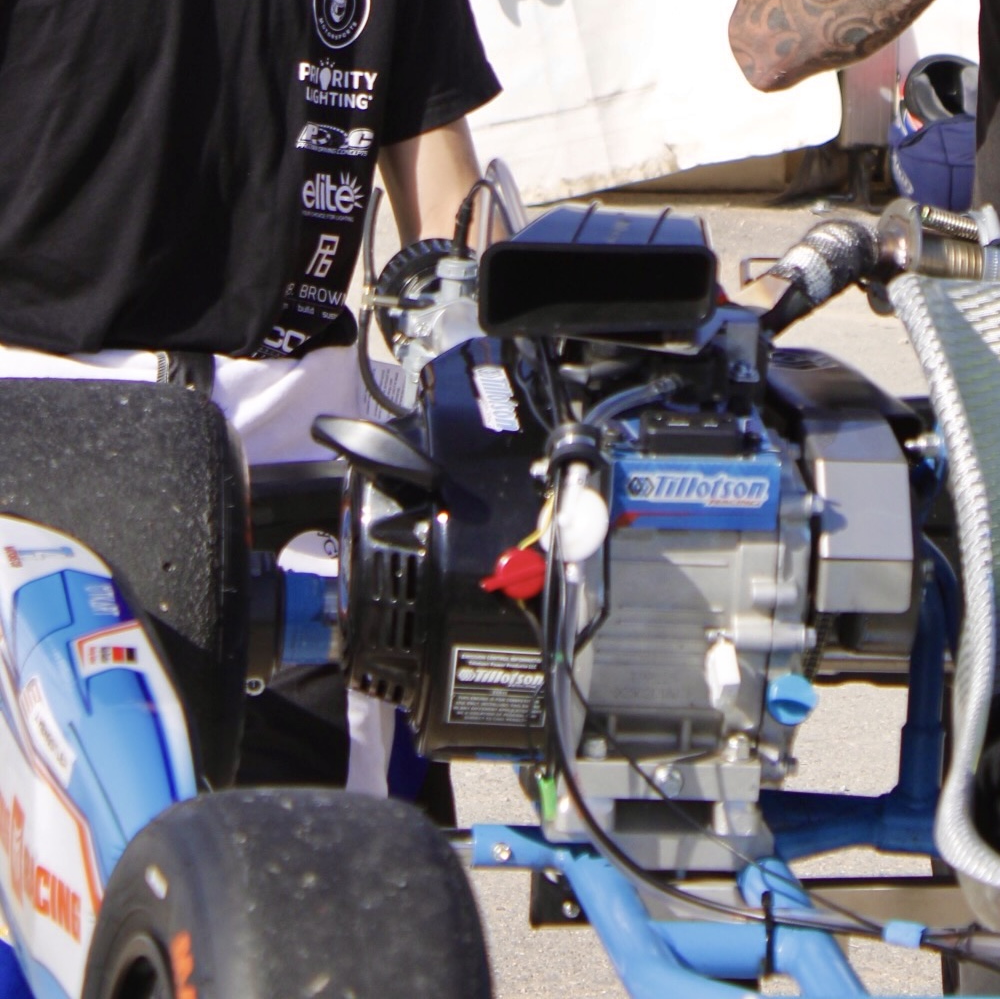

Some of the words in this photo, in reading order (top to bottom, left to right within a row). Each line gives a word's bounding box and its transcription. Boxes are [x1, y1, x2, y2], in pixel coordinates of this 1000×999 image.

[298, 62, 378, 91] PRIORITY
[305, 86, 369, 110] LIGHTING
[302, 173, 355, 214] elite
[653, 474, 766, 499] Tillotson
[474, 670, 544, 686] Tillotson
